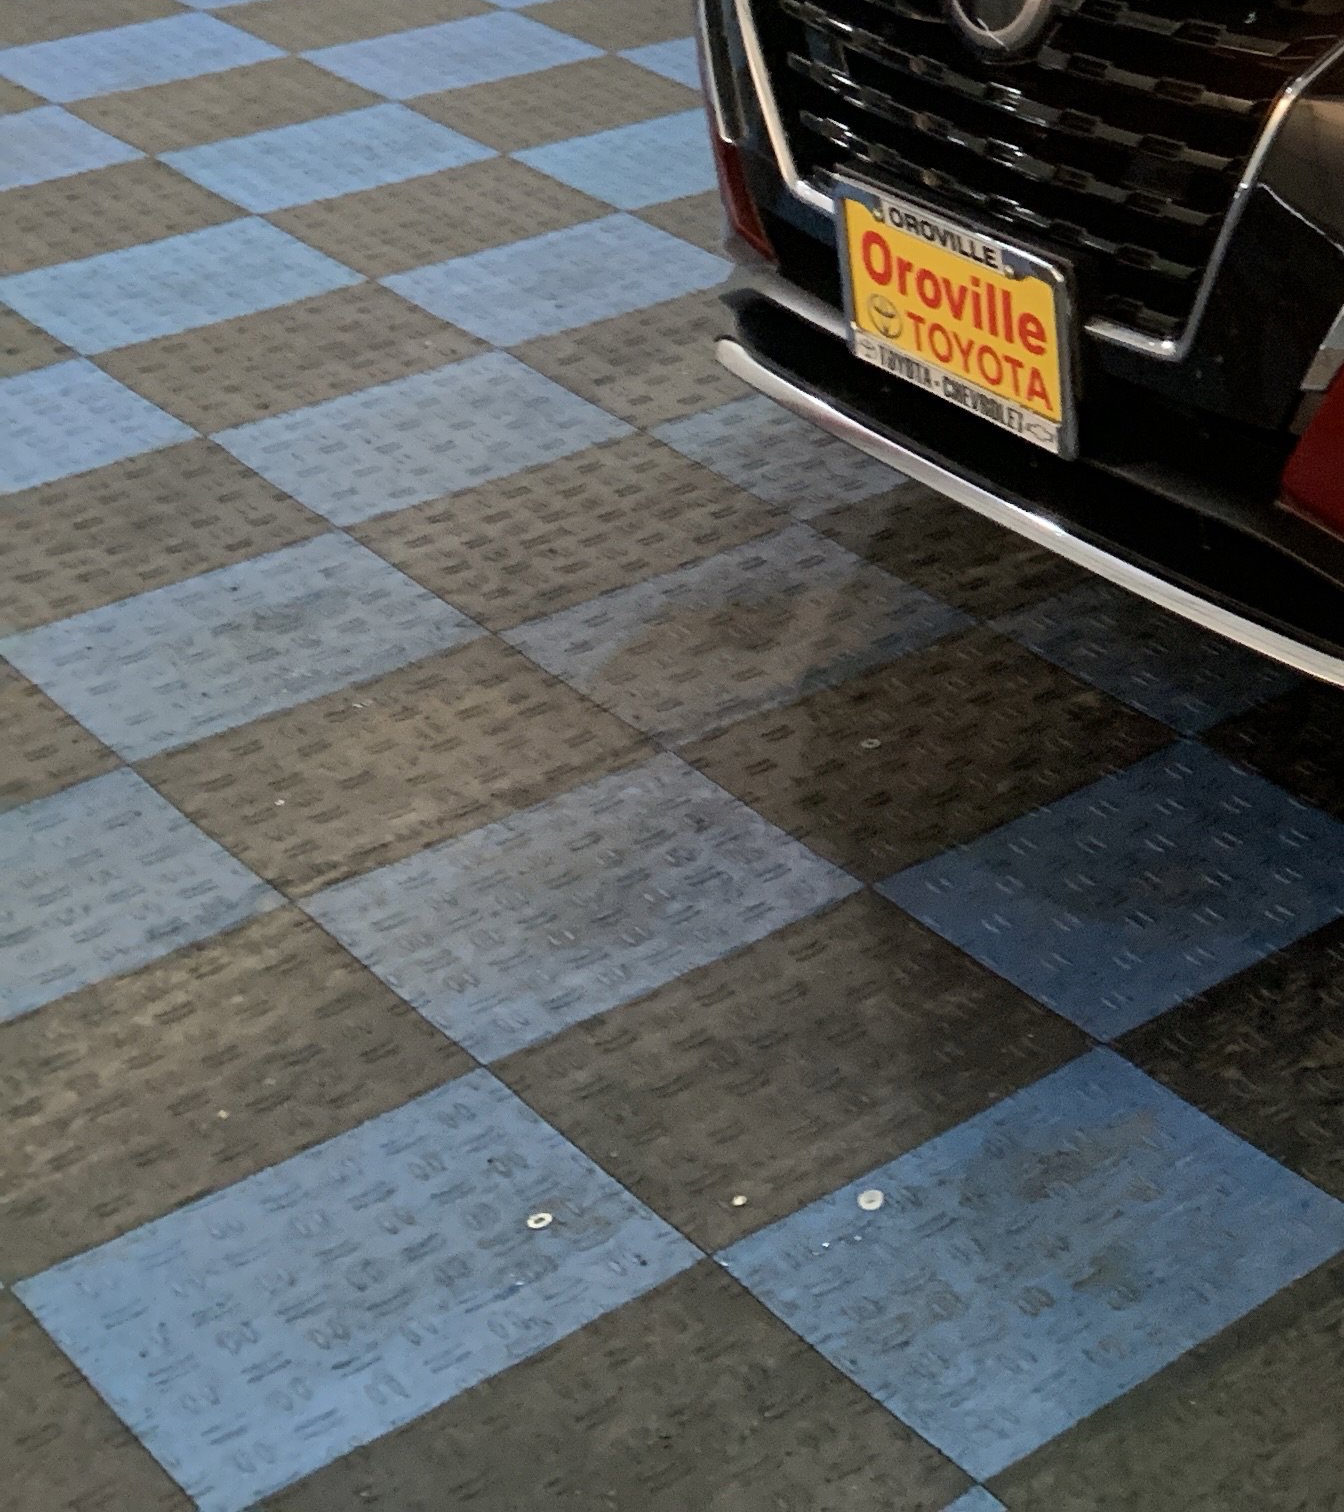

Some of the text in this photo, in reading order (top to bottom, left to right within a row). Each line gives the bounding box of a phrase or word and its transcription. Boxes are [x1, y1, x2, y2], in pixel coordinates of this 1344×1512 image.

[888, 207, 1000, 270] OROVILLE
[861, 230, 1048, 356] Oroville
[904, 311, 1054, 412] TOYOTA
